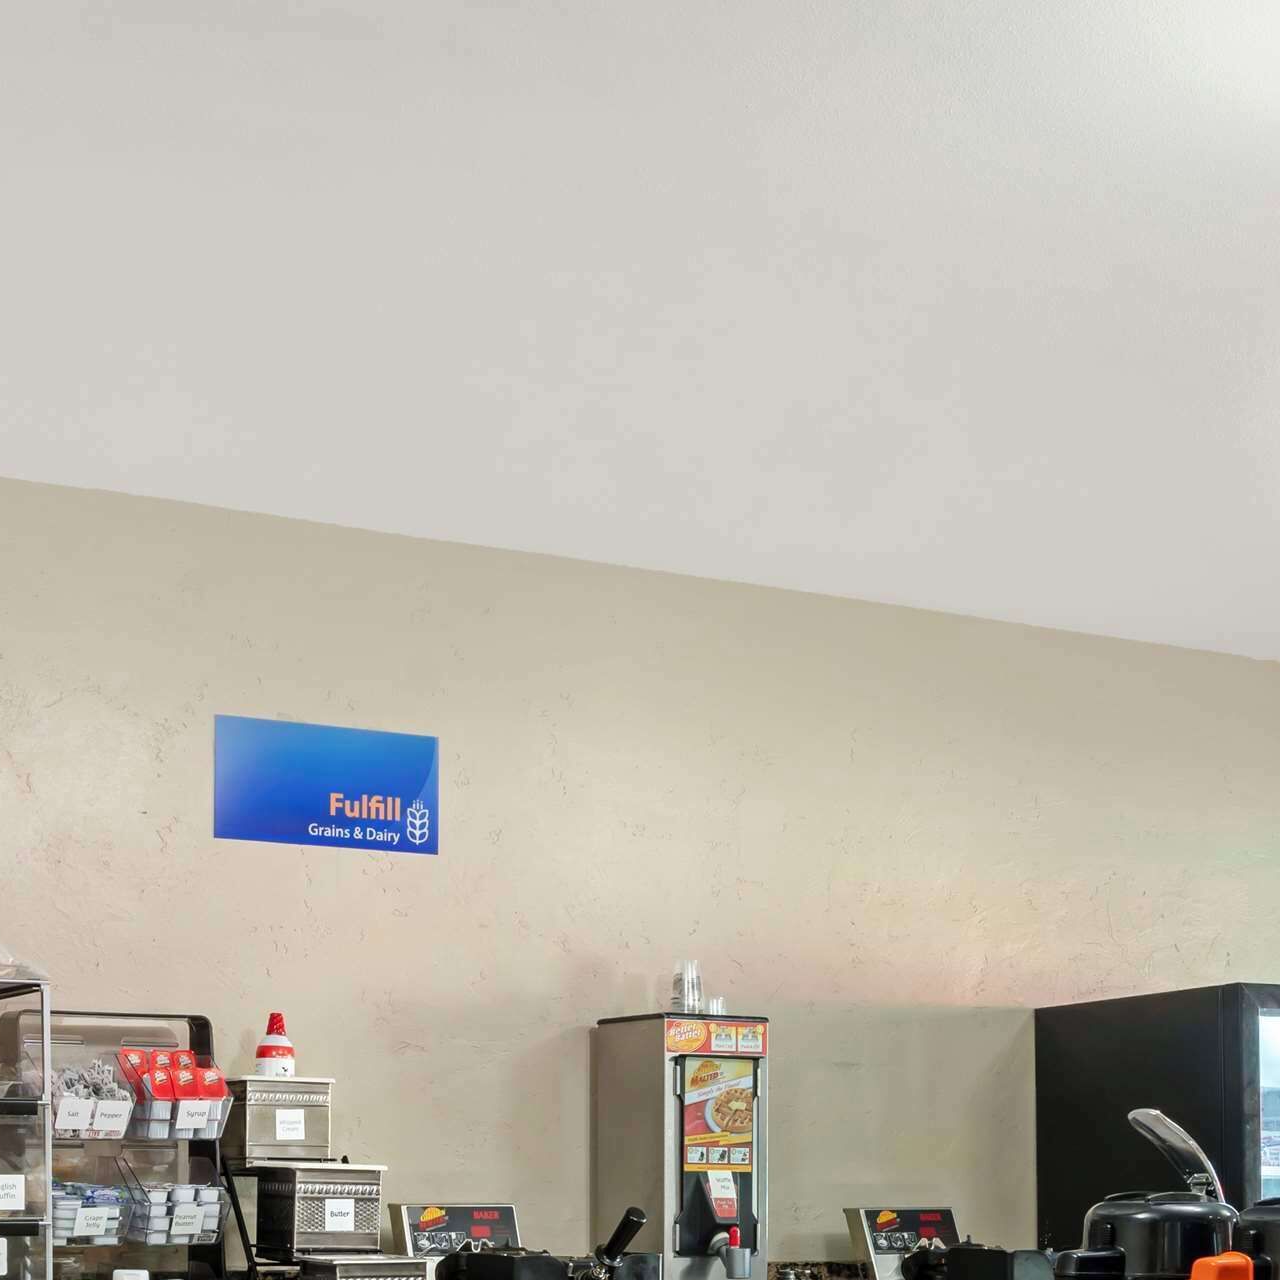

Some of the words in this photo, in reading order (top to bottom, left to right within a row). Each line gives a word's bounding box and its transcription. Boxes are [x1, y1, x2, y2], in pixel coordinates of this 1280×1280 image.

[329, 792, 401, 822] Fulfill
[308, 822, 351, 839] Grains
[353, 826, 363, 840] &
[366, 828, 401, 845] Dairy
[99, 1111, 123, 1119] Pepper
[186, 1110, 207, 1118] Syrup
[329, 1209, 350, 1218] Butter
